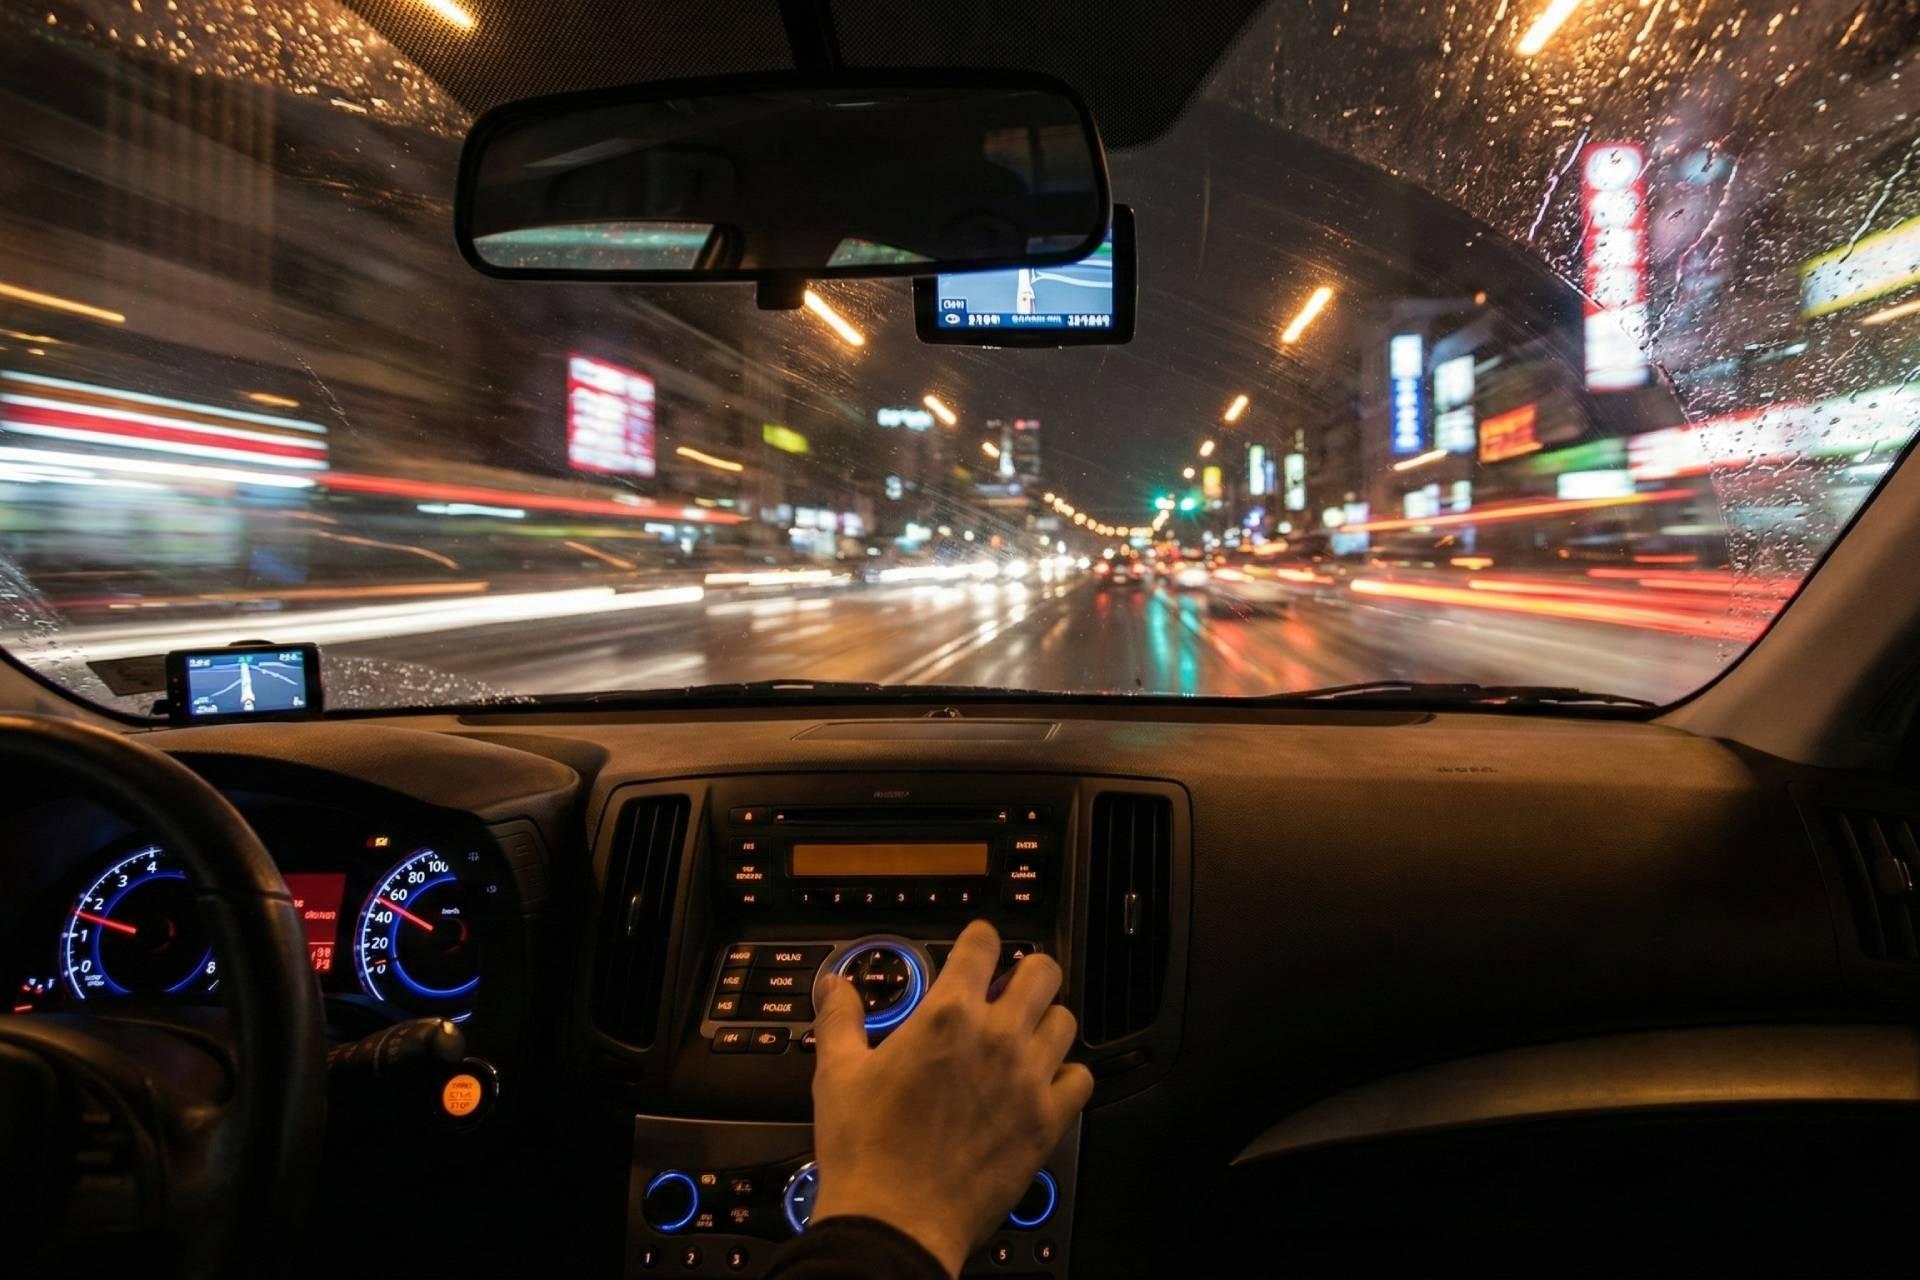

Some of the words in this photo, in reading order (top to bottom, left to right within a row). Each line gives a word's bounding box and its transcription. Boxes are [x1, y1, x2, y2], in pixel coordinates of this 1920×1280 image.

[146, 861, 157, 873] 4
[117, 875, 128, 887] 3
[408, 872, 425, 883] 80
[390, 888, 408, 901] 60
[93, 898, 104, 910] 2
[374, 911, 393, 924] 40
[81, 929, 88, 943] 1
[371, 937, 388, 950] 20
[80, 960, 92, 973] 0
[376, 963, 386, 974] 0
